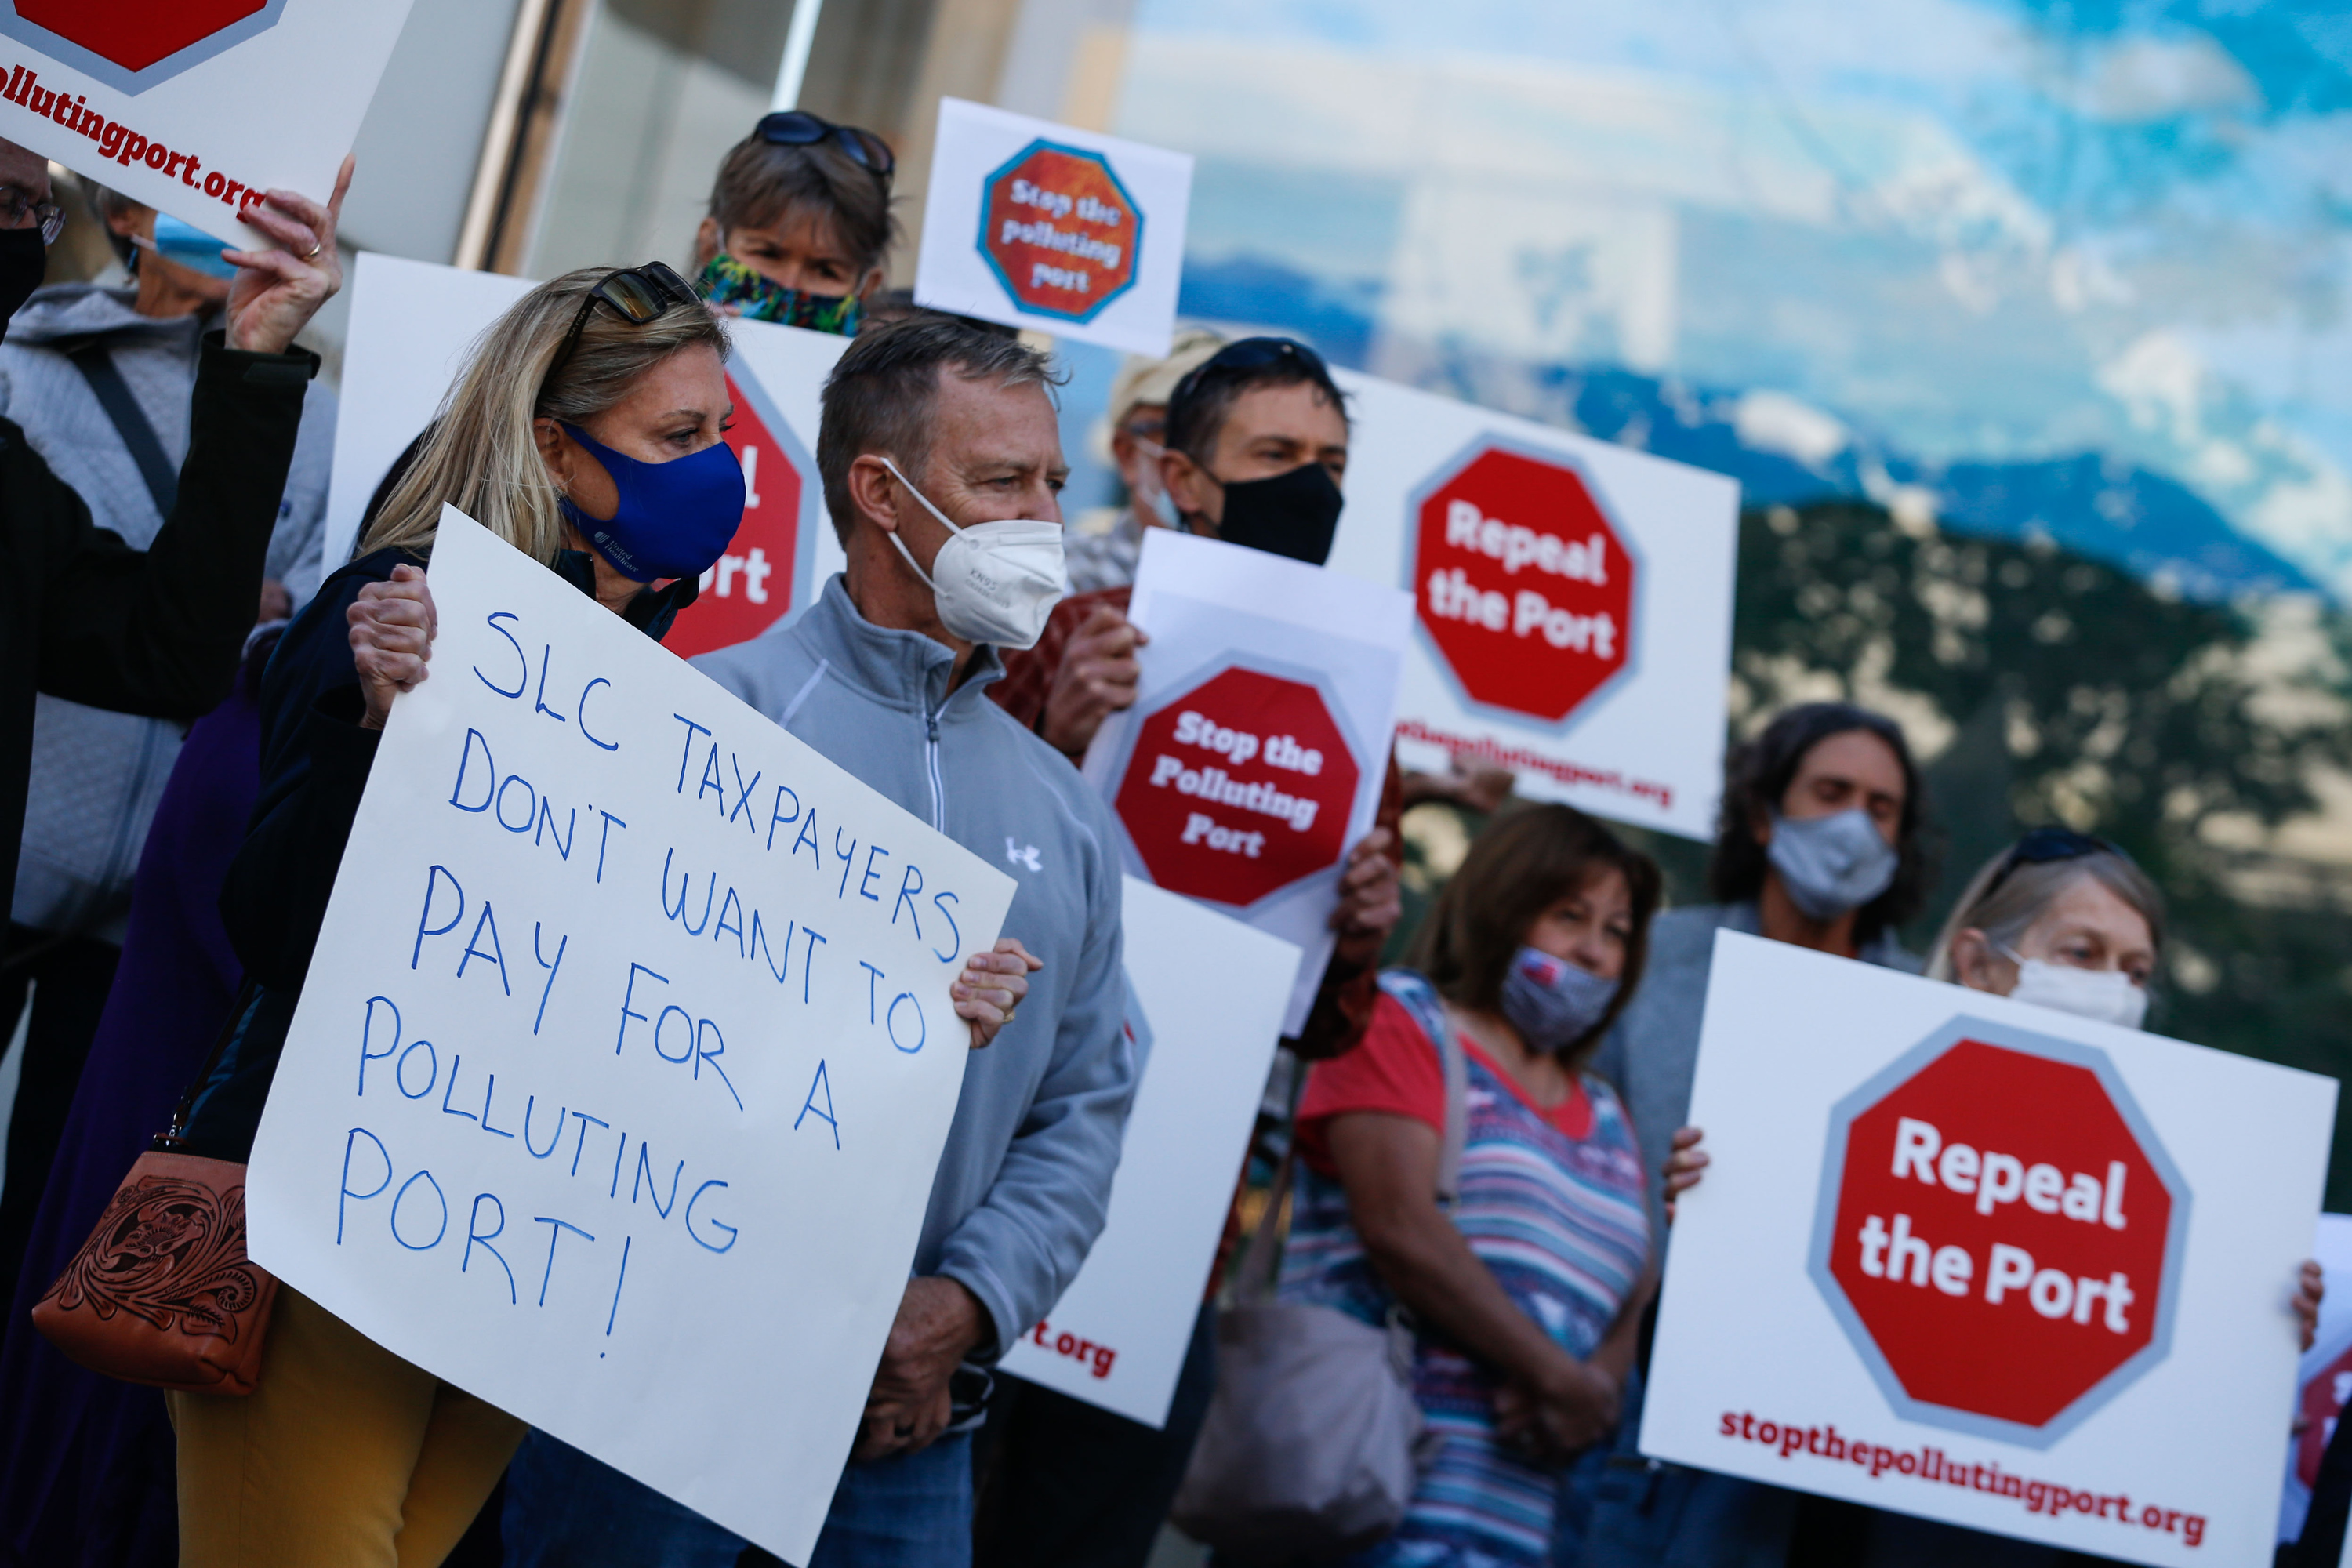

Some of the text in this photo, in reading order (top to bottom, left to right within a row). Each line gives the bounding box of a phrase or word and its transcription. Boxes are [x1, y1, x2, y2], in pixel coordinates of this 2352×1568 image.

[1000, 219, 1122, 270] polluting
[1010, 179, 1123, 227] Stop the
[1031, 263, 1091, 294] port
[609, 540, 633, 560] United
[970, 568, 999, 590] KN95
[1446, 499, 1608, 586] Repeal
[1428, 568, 1616, 659] the Port
[1174, 710, 1323, 775] Stop the
[474, 612, 960, 964] SLC TAXPAYERS
[1150, 755, 1319, 831] Polluting
[1181, 813, 1264, 857] Port
[448, 728, 926, 1054] DON'T WANT TO
[412, 865, 840, 1150] PAY FOR A
[358, 996, 738, 1254] POLLUTING
[1891, 1117, 2127, 1230] Repeal
[337, 1128, 630, 1358] PORT!
[1859, 1214, 2135, 1334] the Port
[1721, 1412, 2206, 1547] stopthepollutingport.org
